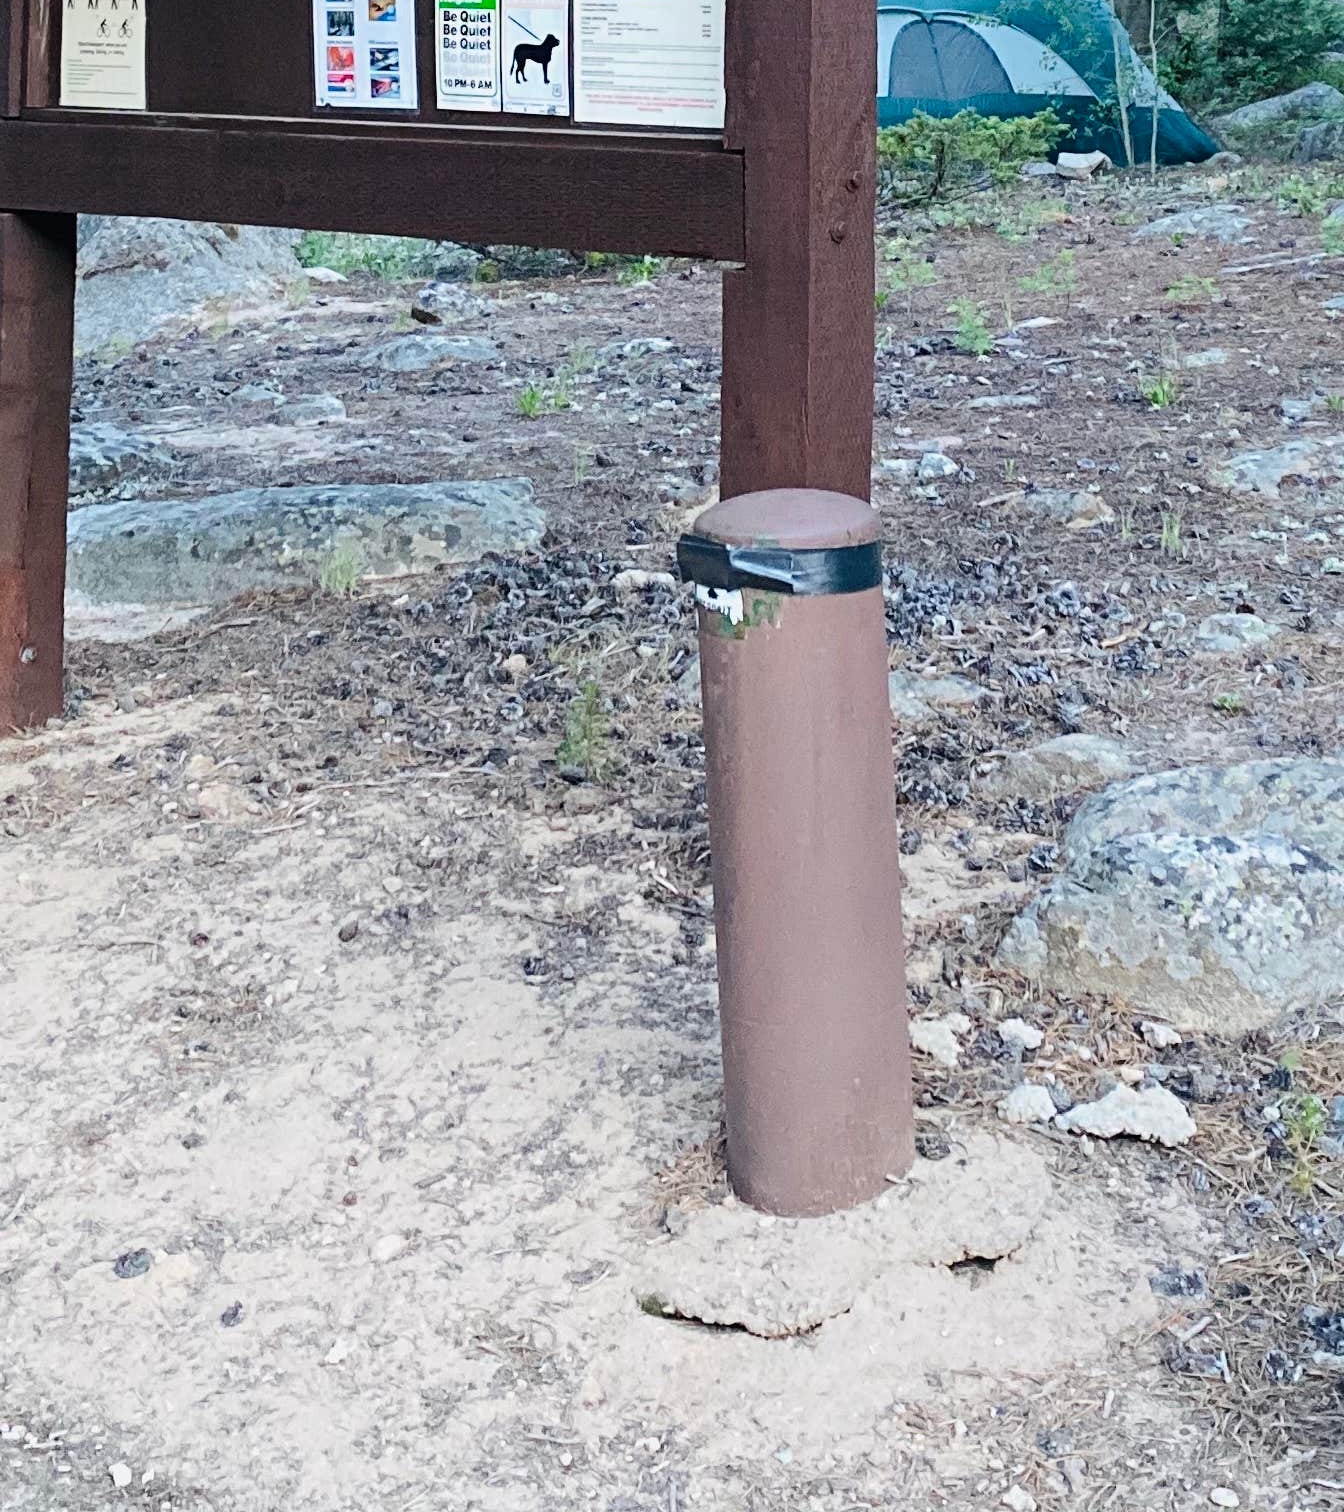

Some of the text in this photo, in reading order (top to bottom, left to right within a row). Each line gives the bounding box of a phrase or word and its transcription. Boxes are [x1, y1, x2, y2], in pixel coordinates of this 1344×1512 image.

[443, 11, 491, 23] Be Quiet
[443, 24, 491, 36] Be Quiet
[443, 38, 491, 50] Be Quiet
[478, 80, 492, 89] AM
